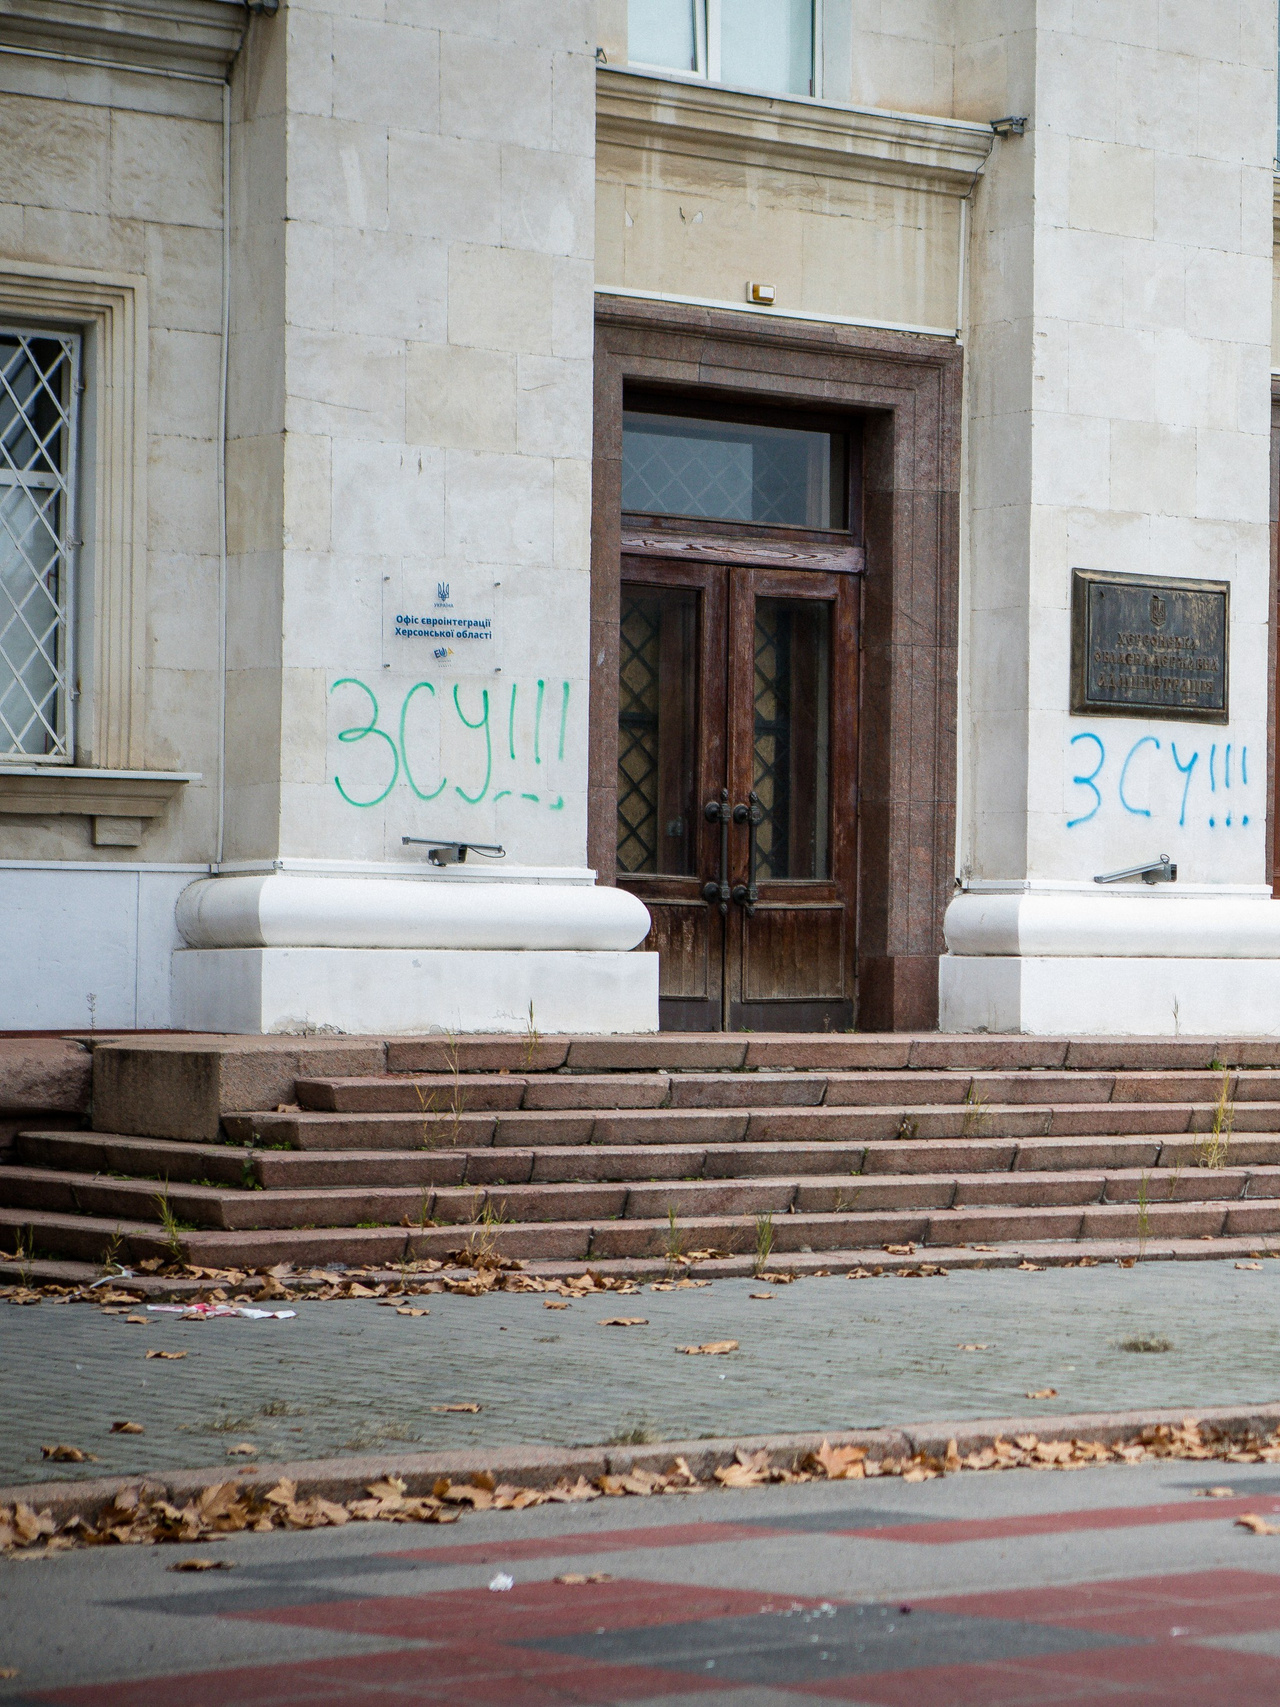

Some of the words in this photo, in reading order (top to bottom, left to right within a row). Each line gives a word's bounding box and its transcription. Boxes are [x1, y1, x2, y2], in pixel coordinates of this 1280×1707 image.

[396, 615, 419, 626] Офіс
[421, 617, 491, 629] євроінтеграції
[395, 627, 455, 638] Херсонської
[456, 630, 492, 640] області
[1116, 632, 1198, 651] ХЕРСОНСЬКА
[1097, 673, 1215, 697] АДМІНІСТРАЦІЯ
[331, 677, 569, 810] ЗСУ!!!
[1066, 732, 1249, 829] ЗСУ!!!
